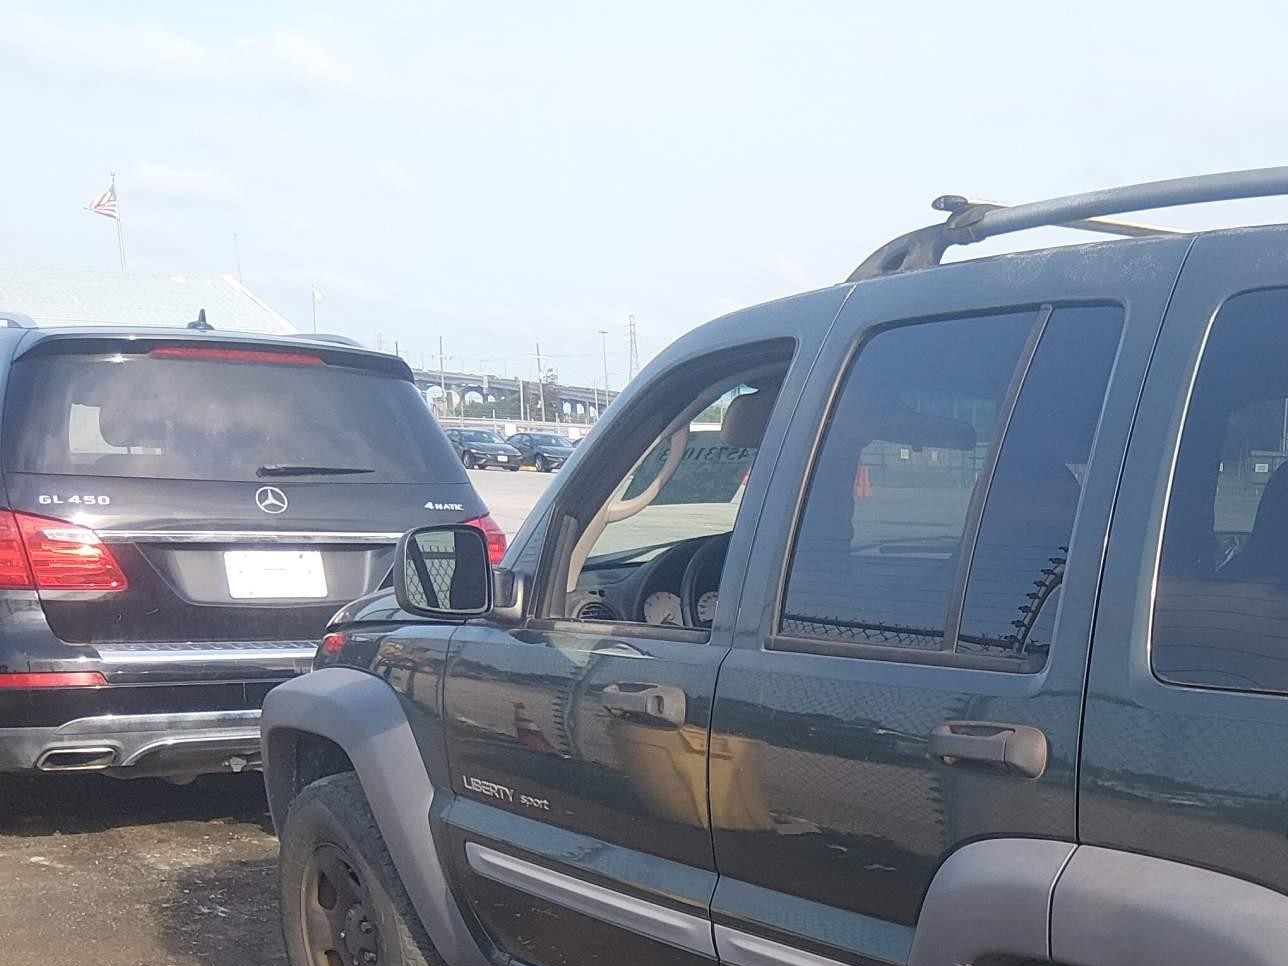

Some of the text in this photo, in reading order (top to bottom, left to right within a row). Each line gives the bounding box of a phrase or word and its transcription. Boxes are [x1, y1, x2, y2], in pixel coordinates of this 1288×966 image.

[39, 494, 111, 506] GL 450
[462, 775, 550, 811] LIBERTY sport
